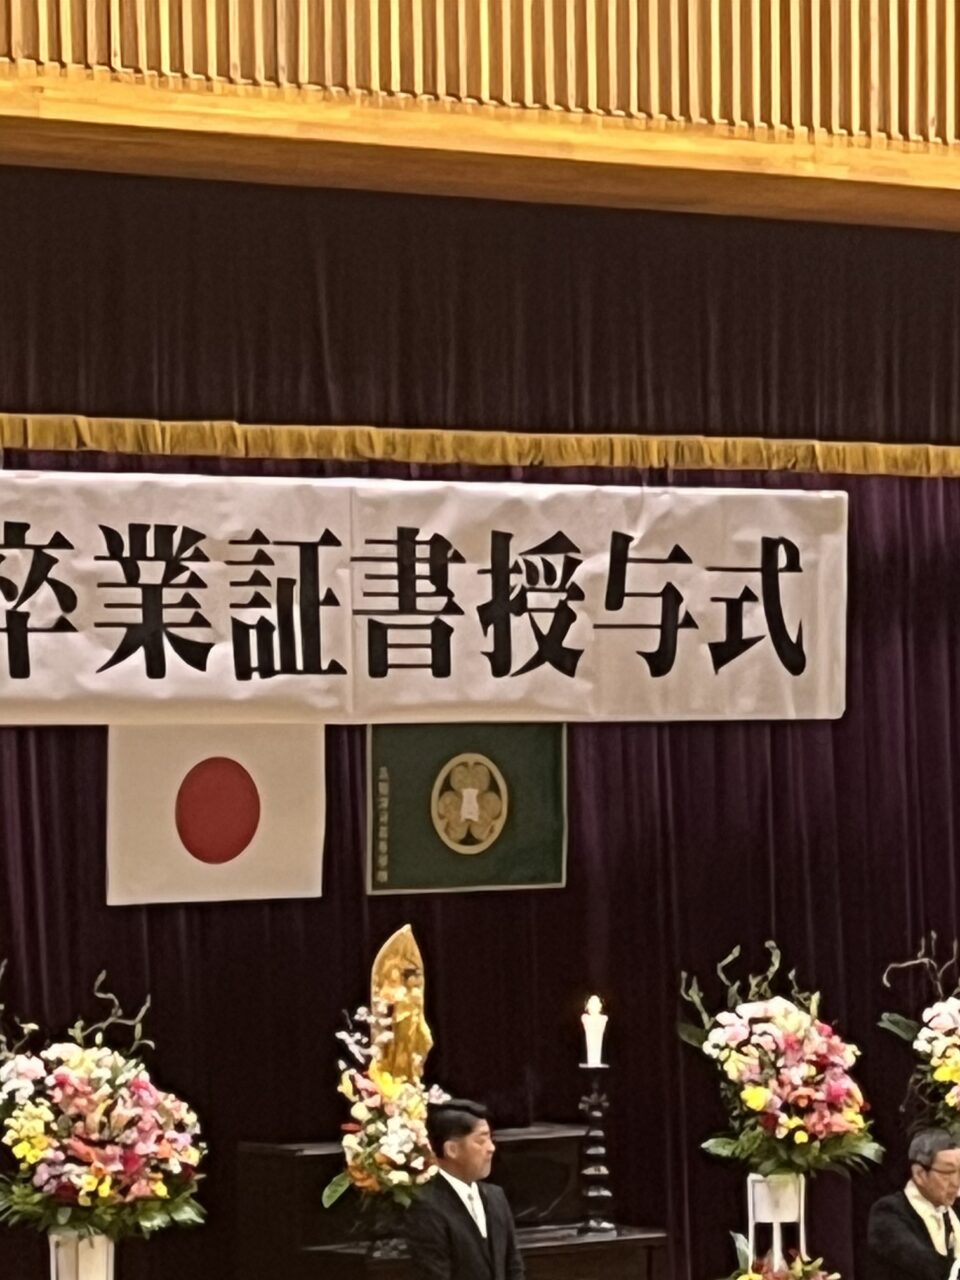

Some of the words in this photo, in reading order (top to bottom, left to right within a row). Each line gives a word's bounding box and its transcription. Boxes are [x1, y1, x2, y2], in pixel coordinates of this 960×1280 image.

[0, 521, 806, 680] 卒業証書授与式
